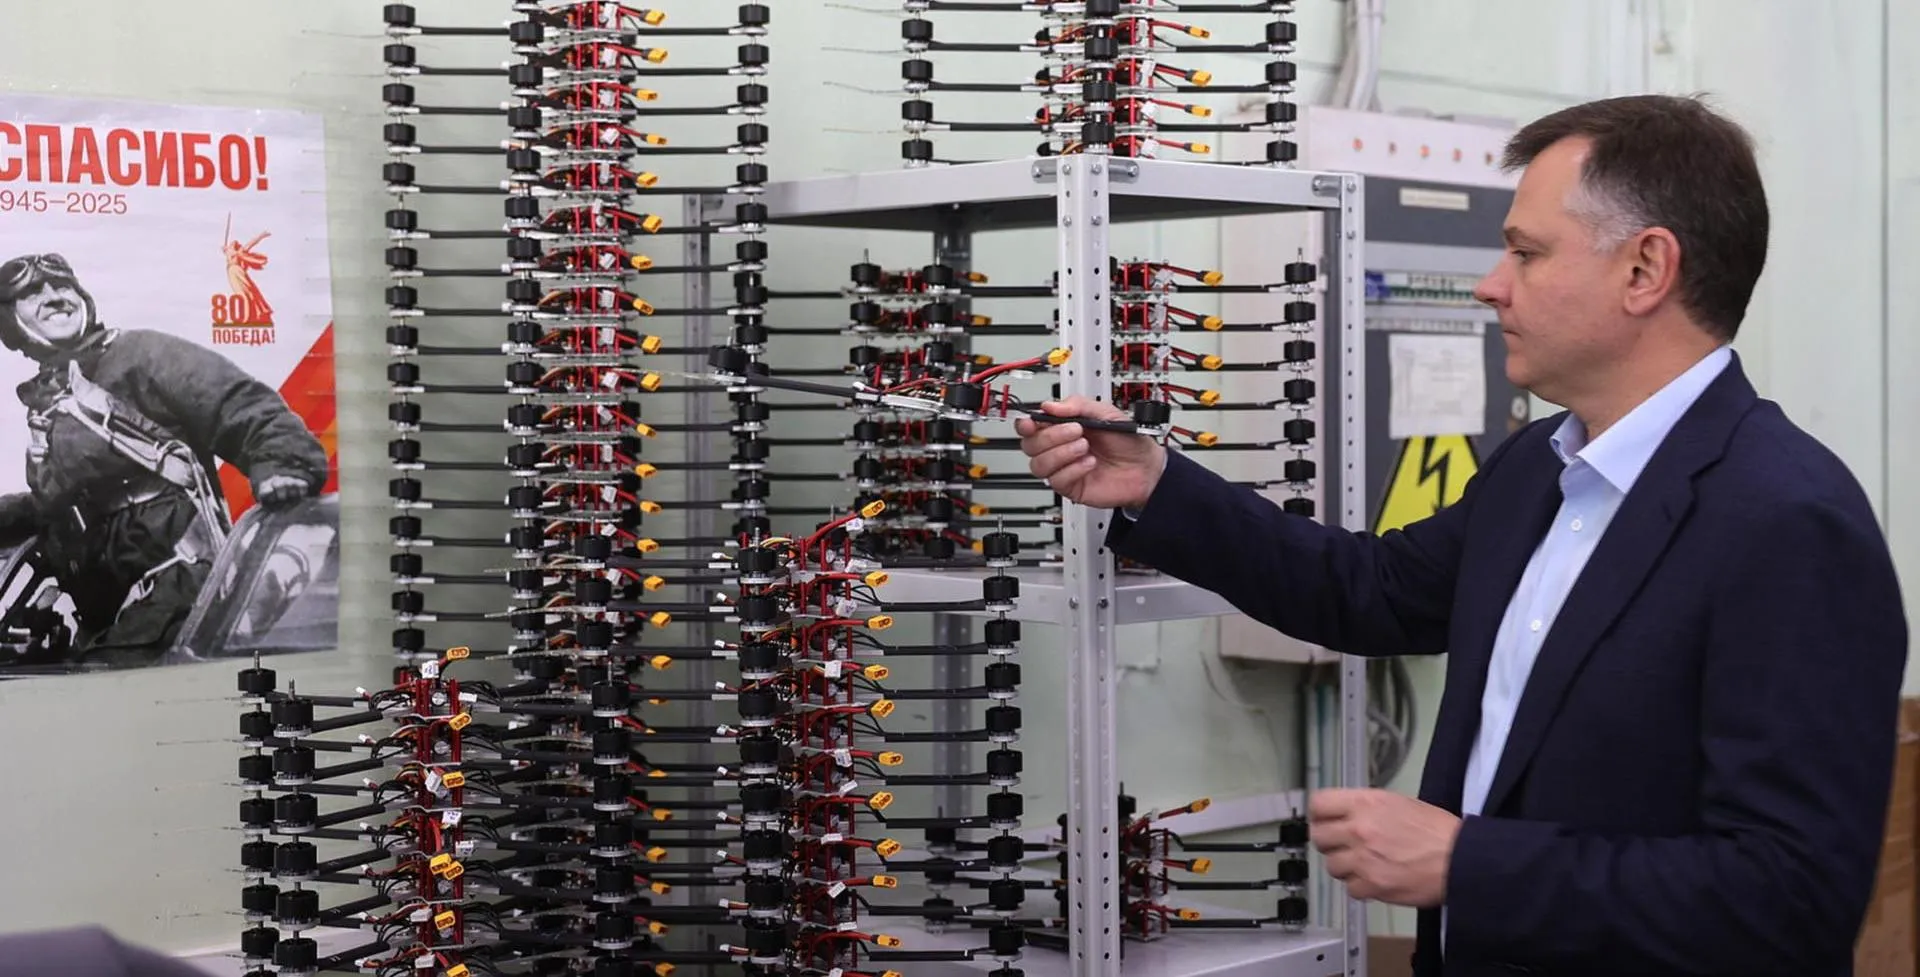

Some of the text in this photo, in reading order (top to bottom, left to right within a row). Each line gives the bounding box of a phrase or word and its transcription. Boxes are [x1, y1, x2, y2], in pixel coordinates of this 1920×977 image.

[0, 121, 268, 191] СПАСИБО!
[211, 294, 245, 324] 80
[212, 329, 275, 346] ПОБЕДА!
